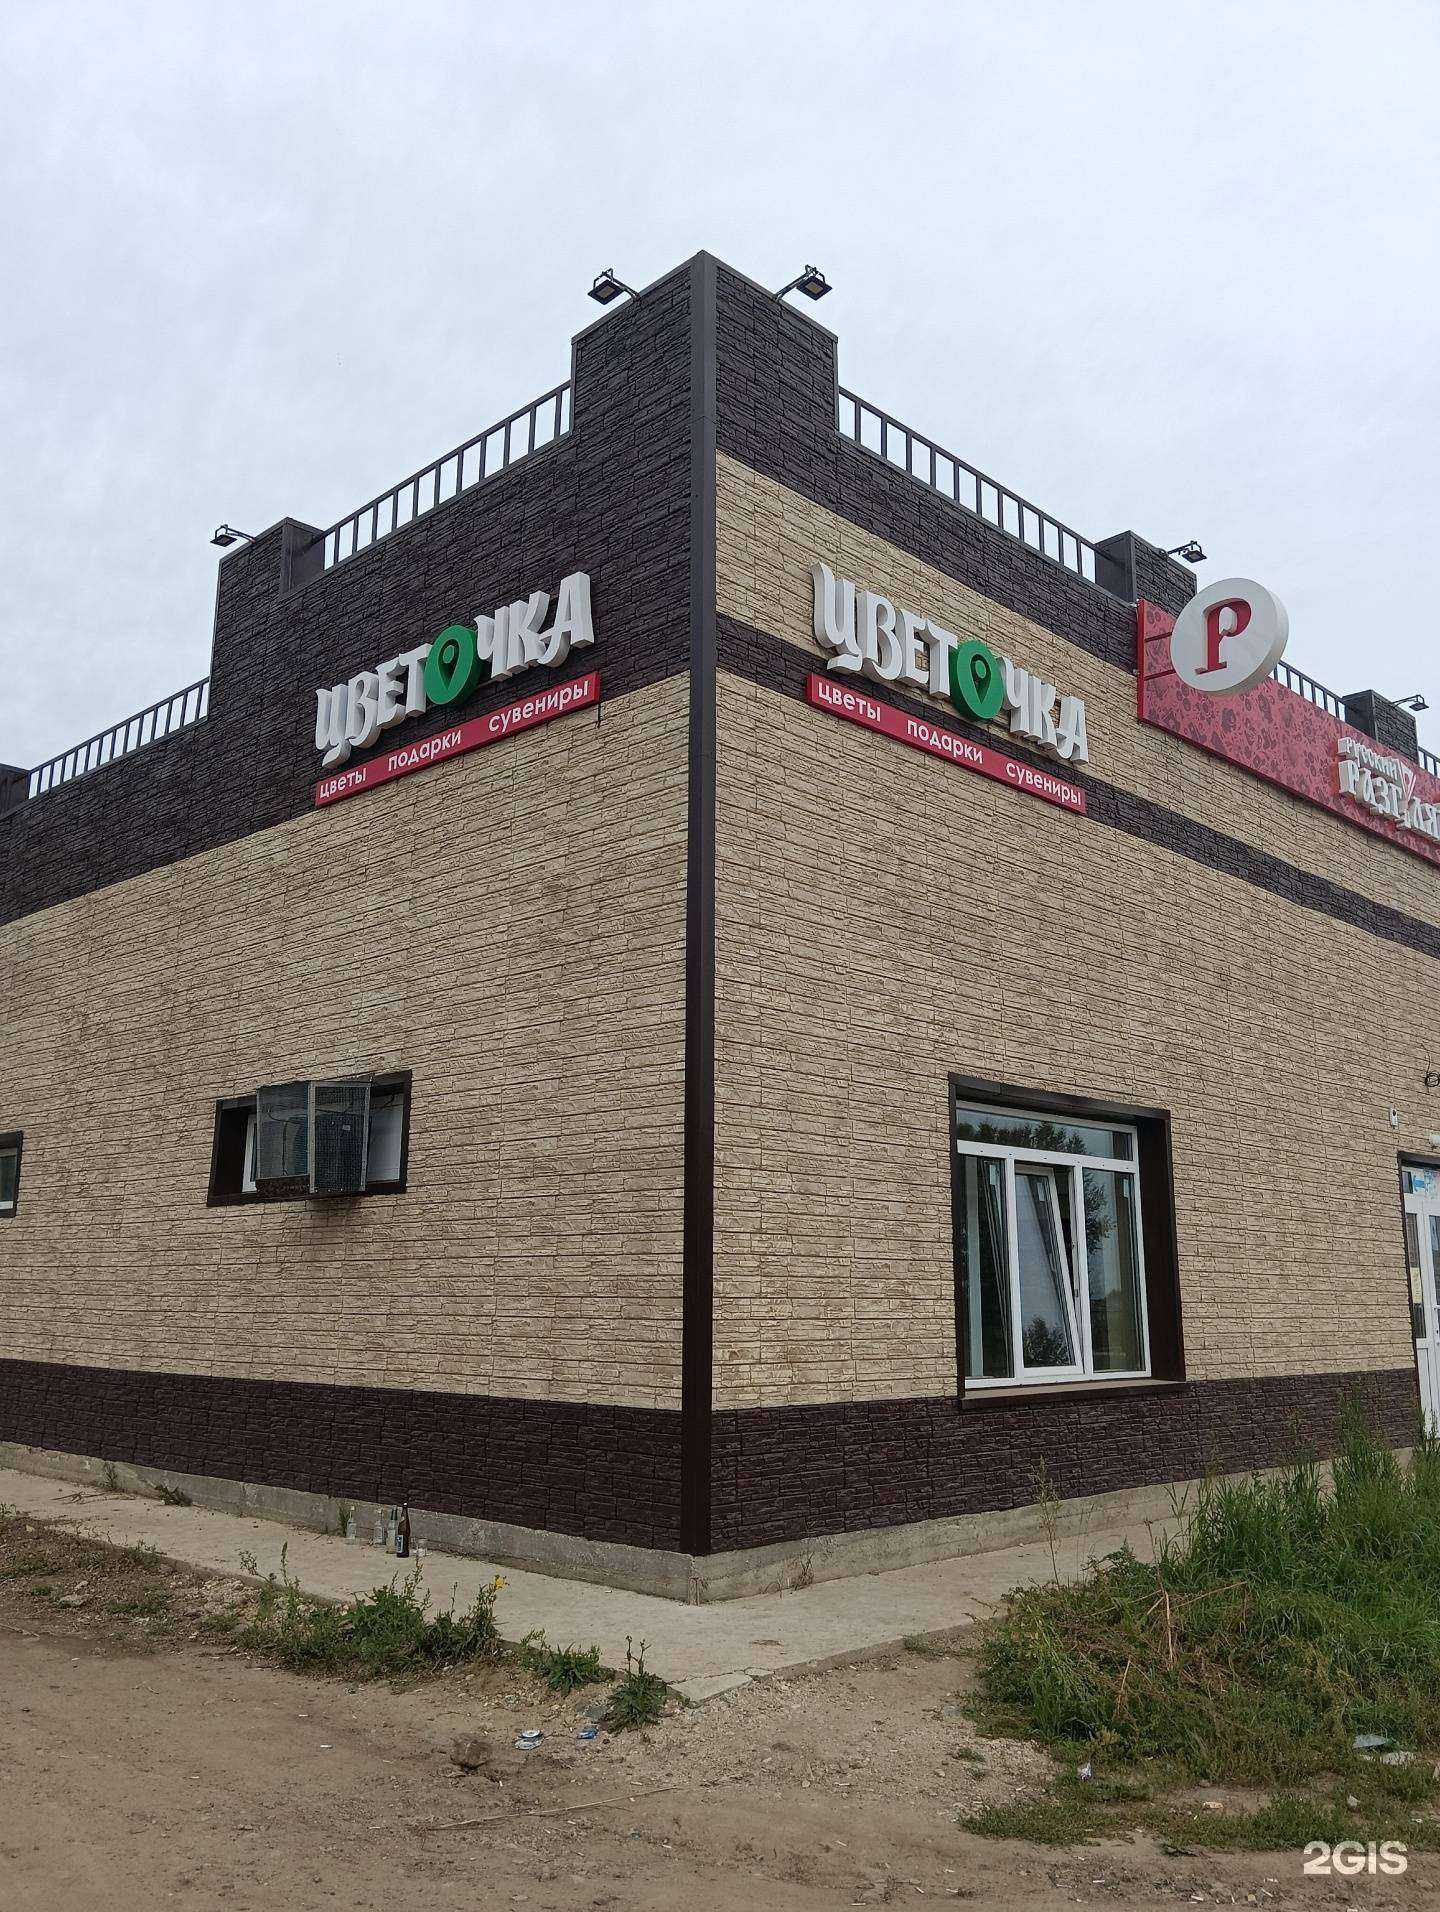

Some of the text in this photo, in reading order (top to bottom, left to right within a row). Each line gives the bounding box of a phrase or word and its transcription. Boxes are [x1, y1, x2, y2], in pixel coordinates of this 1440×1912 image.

[315, 572, 594, 767] ЦВЕТОЧКА
[319, 680, 589, 799] цветы подарки сувениры
[810, 561, 1089, 766] ЦВЕТОЧКА
[818, 682, 1082, 807] цветы подарки сувениры
